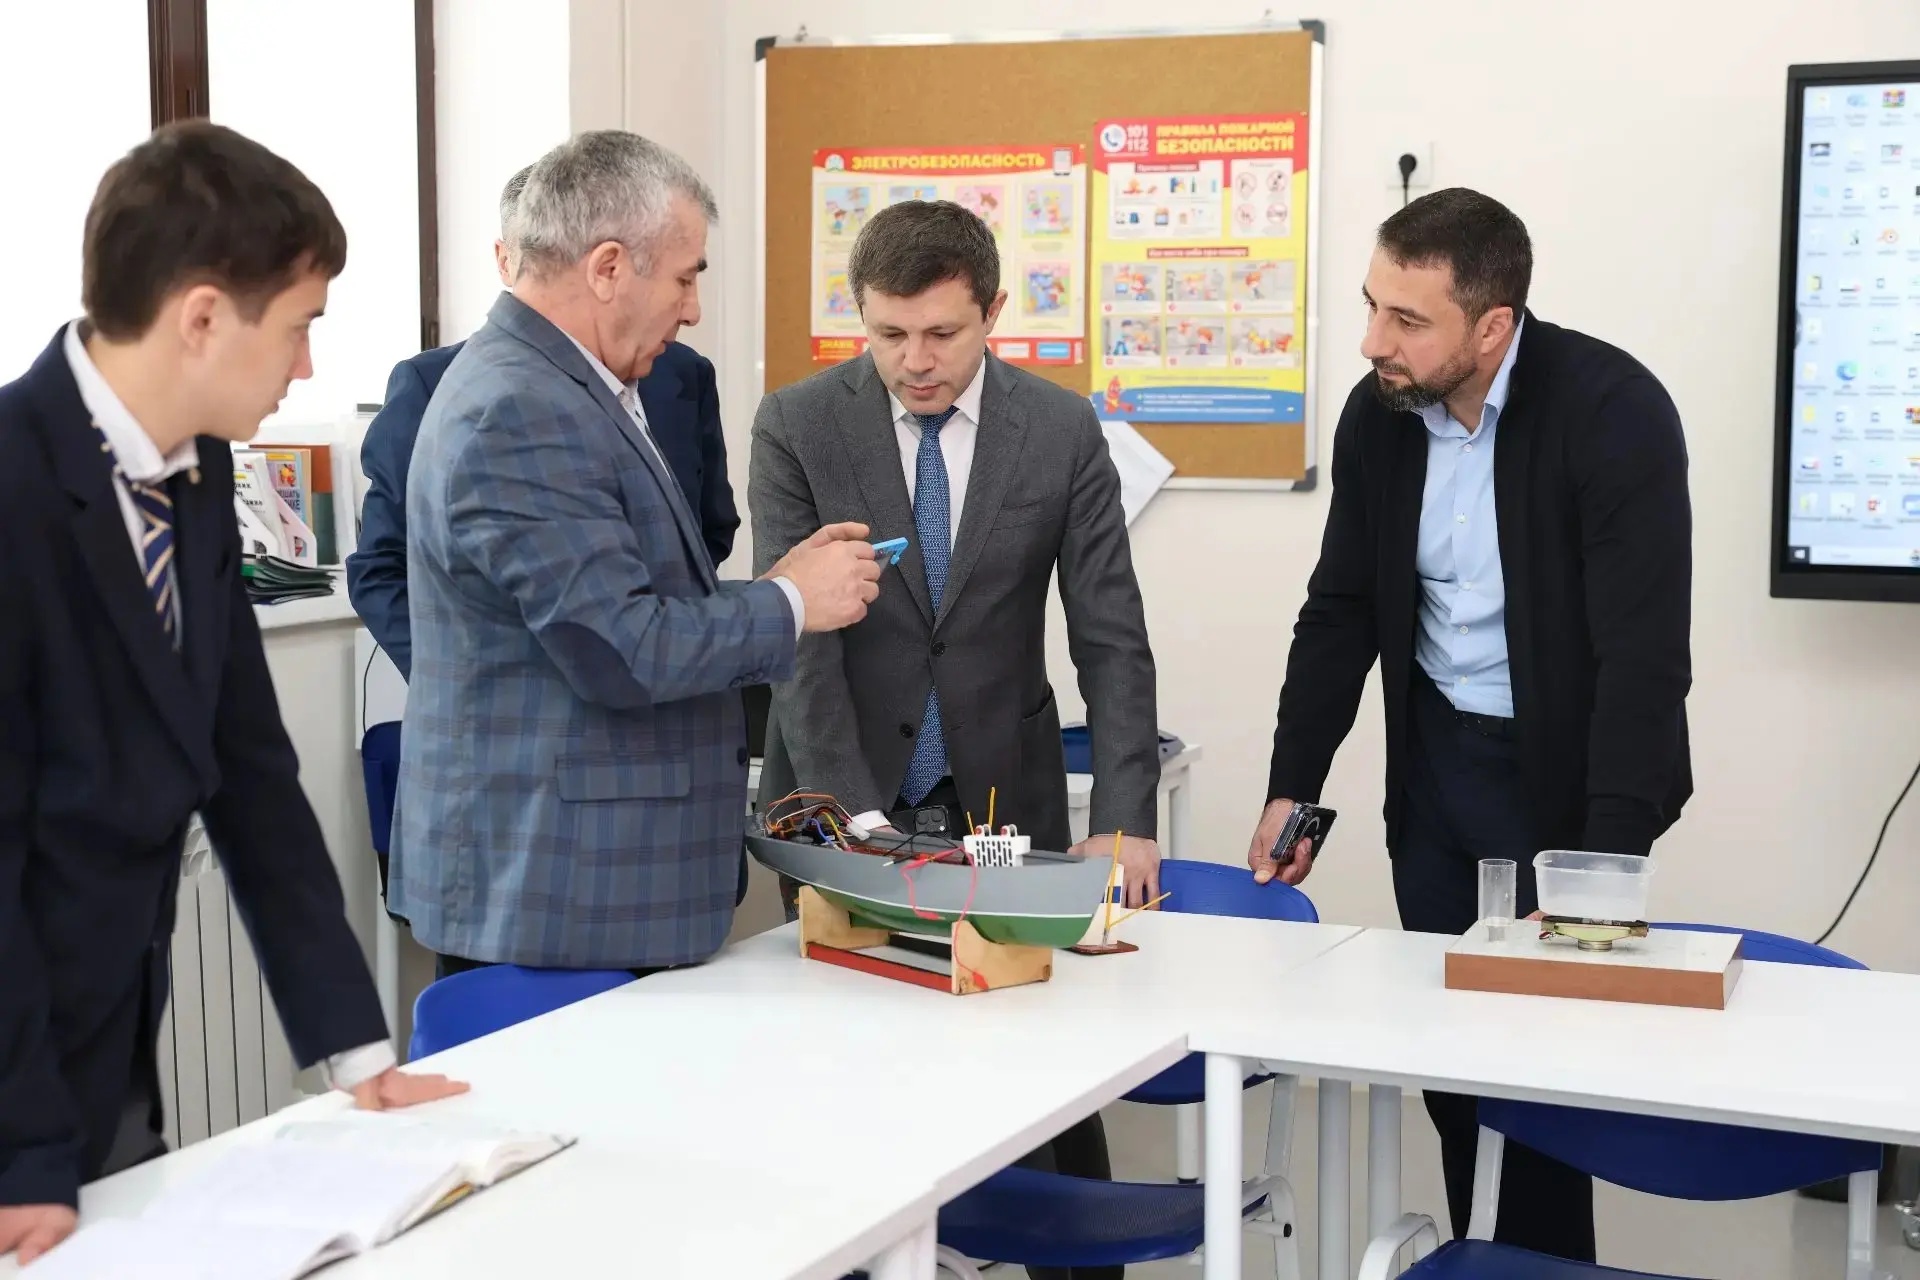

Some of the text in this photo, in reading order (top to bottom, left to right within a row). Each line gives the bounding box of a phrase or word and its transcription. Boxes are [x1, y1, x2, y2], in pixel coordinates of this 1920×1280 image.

[1127, 124, 1148, 138] 101
[1156, 118, 1295, 138] ПРАВИЛА ПОЖАРНОЙ
[1127, 138, 1149, 152] 112
[1156, 135, 1294, 155] БЕЗОПАСНОСТИ
[851, 152, 1047, 170] ЭЛЕКТРОБЕЗОПАСНОСТЬ
